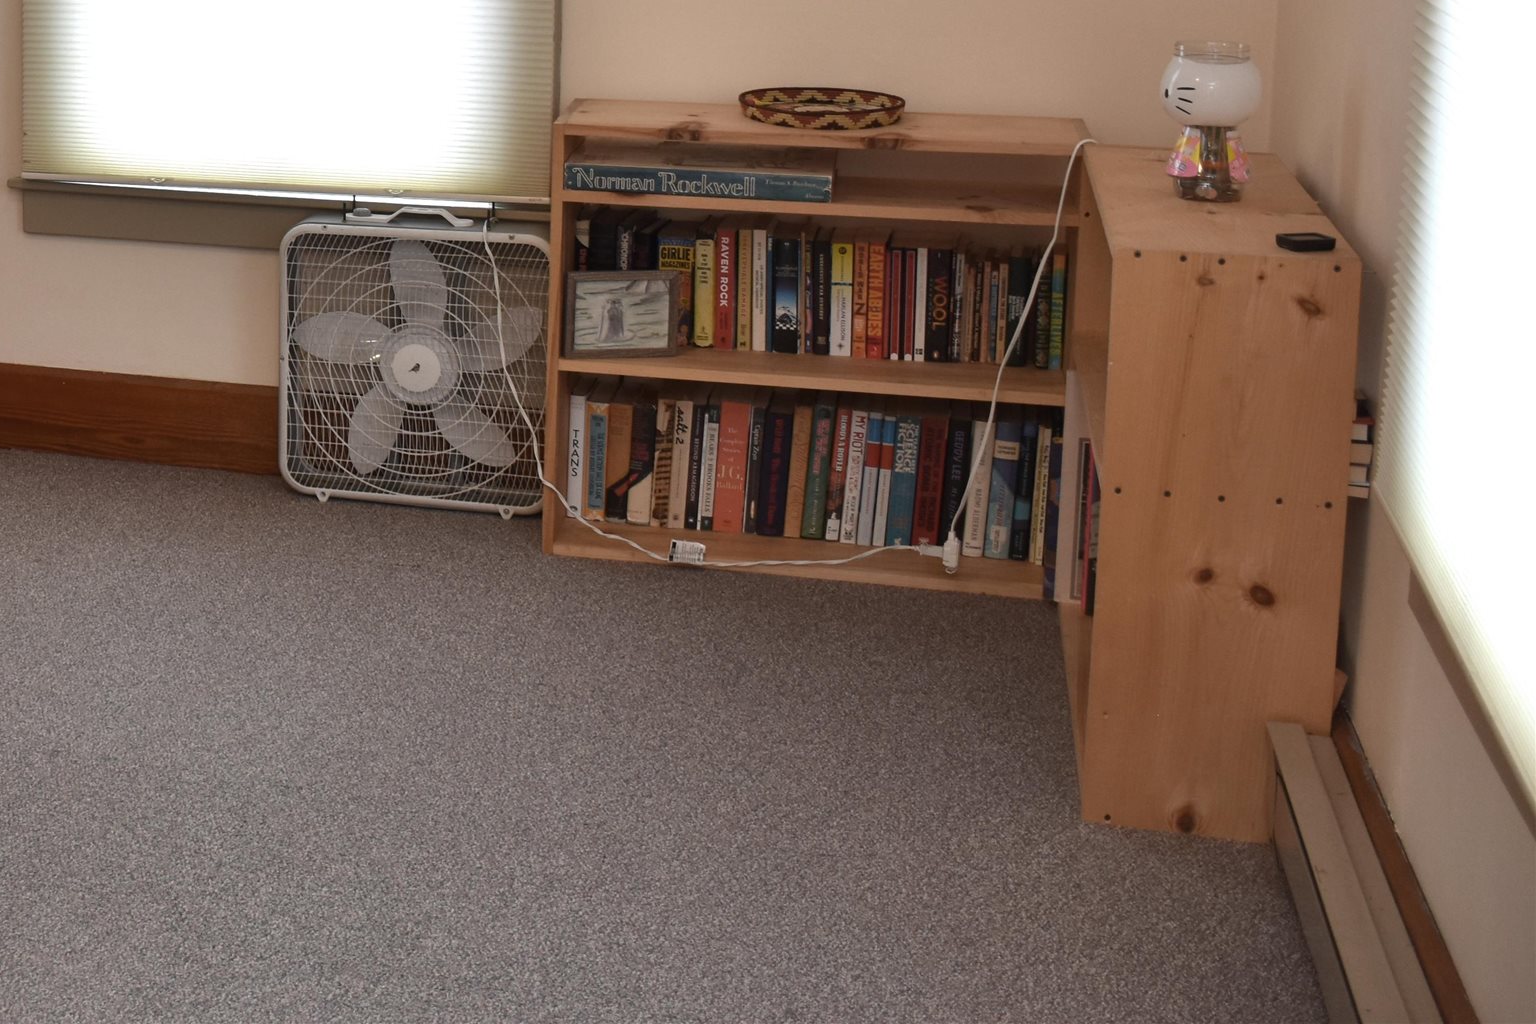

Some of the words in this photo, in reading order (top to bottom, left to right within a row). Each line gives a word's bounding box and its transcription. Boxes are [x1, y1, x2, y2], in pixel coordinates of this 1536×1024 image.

[572, 167, 655, 192] Norman
[657, 172, 756, 197] Rockwell
[619, 232, 630, 271] CHRONOP
[661, 247, 690, 261] GIRLIE
[720, 236, 730, 273] RAVEN
[868, 245, 884, 287] EARTH
[719, 276, 729, 307] ROCK
[740, 287, 748, 318] DAMAGE
[931, 276, 948, 331] WOOL
[1052, 291, 1064, 356] AFTERLIVES
[675, 406, 688, 436] salt
[838, 414, 848, 440] BLOOD'S
[855, 415, 867, 429] MY
[570, 429, 580, 477] TRANS
[675, 437, 684, 445] 2
[692, 438, 700, 460] BEYOND
[708, 433, 716, 456] BEARS
[852, 431, 864, 455] RIOT
[894, 422, 906, 473] FICTION
[903, 423, 916, 473] SCIENCE
[953, 430, 965, 463] GEDDY
[717, 464, 743, 480] J.G.
[835, 447, 845, 472] ROVER
[951, 464, 962, 481] LEE
[690, 462, 699, 502] ARMAGEDDON
[706, 463, 715, 491] BROOKS
[704, 492, 713, 513] FALLS
[973, 488, 983, 507] NAOMI
[970, 509, 980, 541] ALDERMAN
